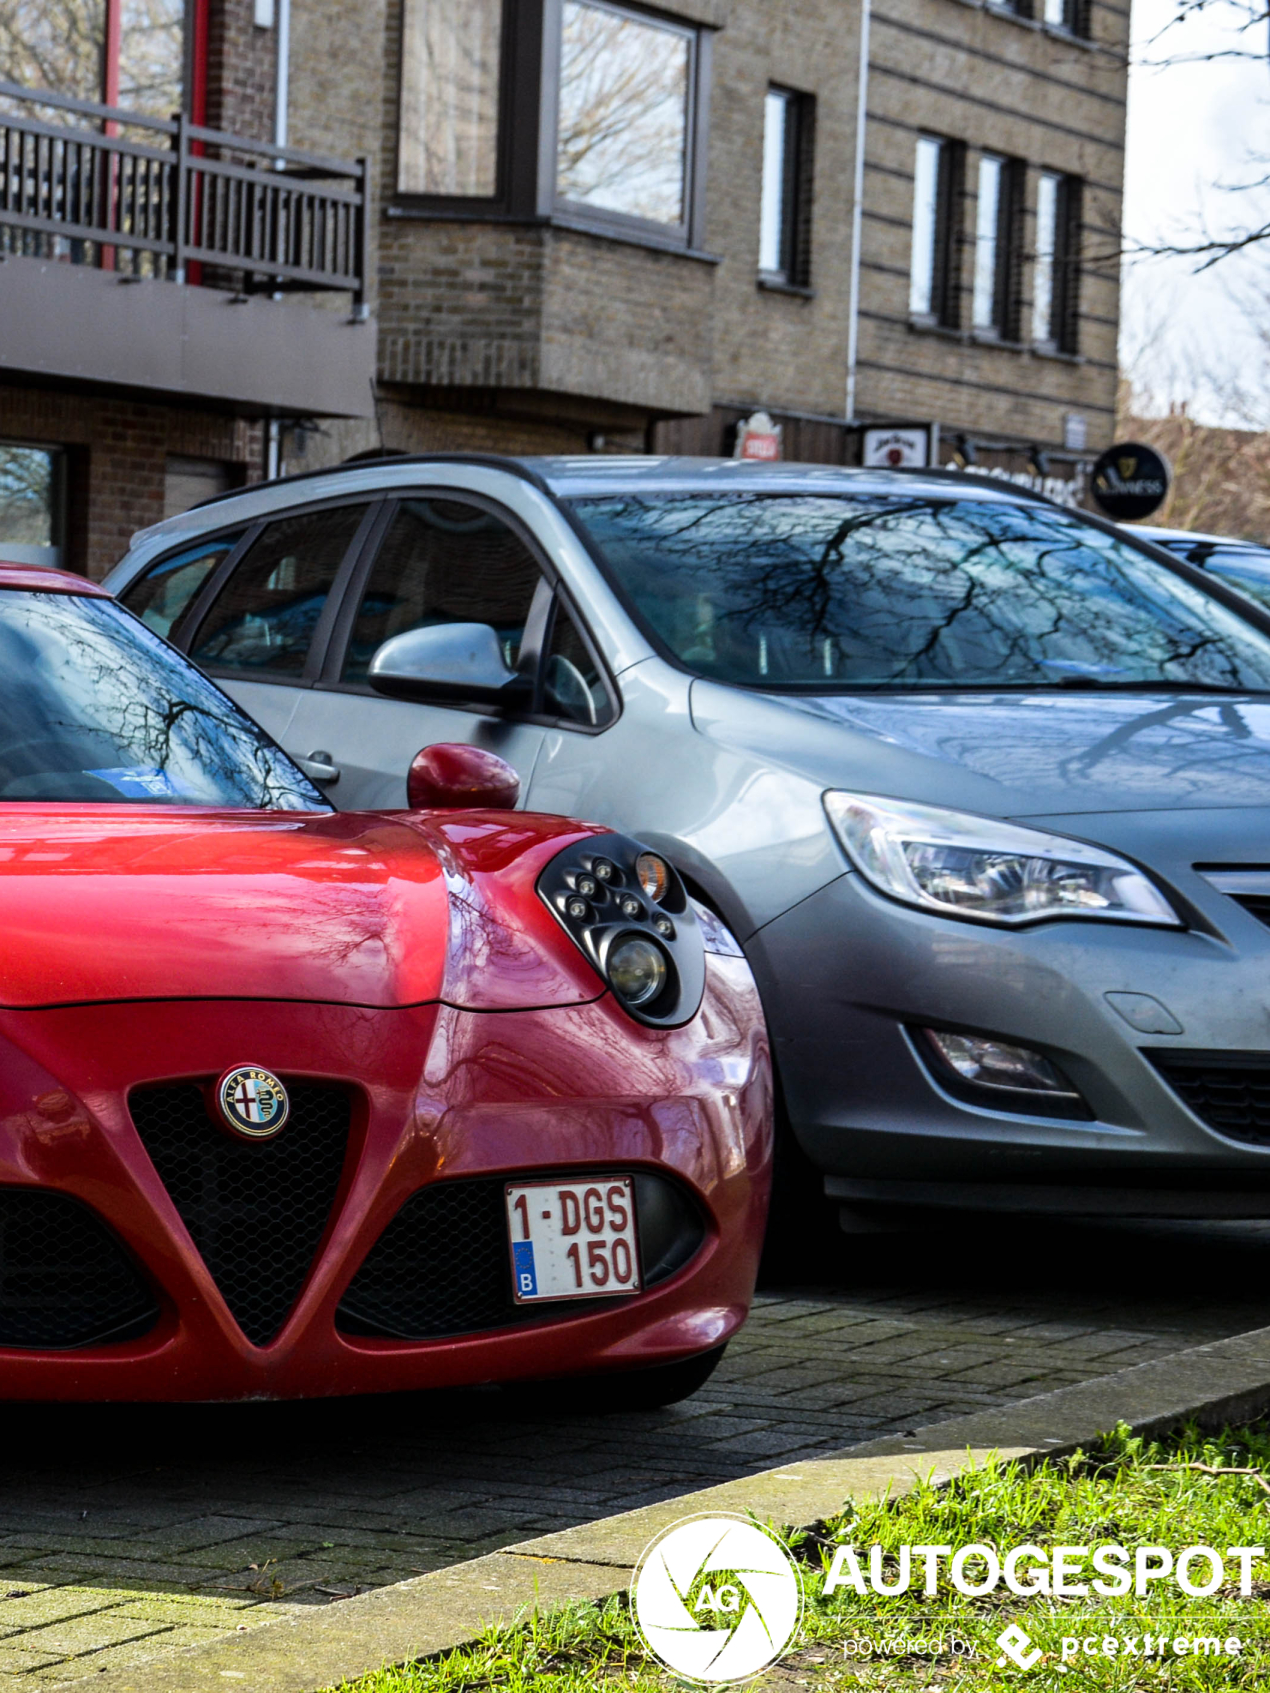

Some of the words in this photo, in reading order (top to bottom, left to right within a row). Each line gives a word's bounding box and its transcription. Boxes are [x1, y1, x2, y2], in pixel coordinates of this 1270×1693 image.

[226, 1075, 245, 1103] ALFA
[249, 1071, 284, 1101] ROMEO
[514, 1185, 629, 1240] 1-DGS
[520, 1273, 533, 1292] B
[567, 1237, 633, 1288] 150
